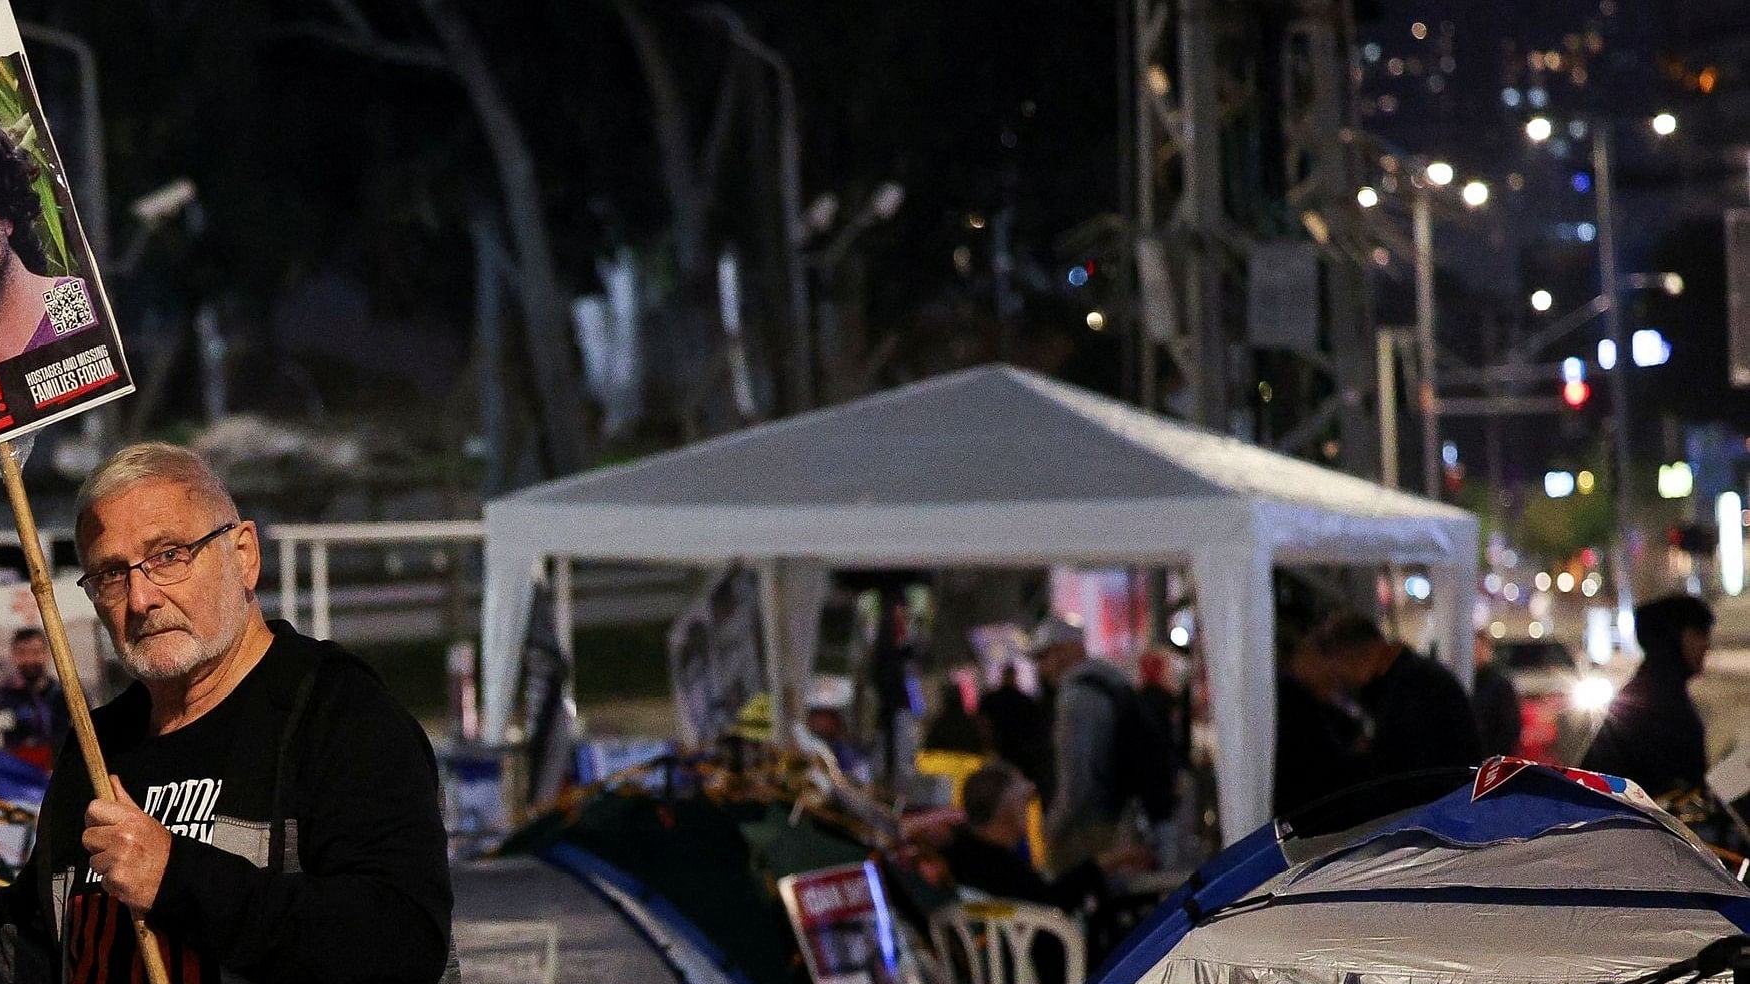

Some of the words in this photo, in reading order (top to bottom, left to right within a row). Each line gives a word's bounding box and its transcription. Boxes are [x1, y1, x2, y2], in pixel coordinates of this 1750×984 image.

[24, 362, 64, 387] HOSTAGES
[61, 356, 78, 373] AND
[76, 344, 109, 368] MISSING
[30, 371, 79, 405] FAMILIES
[76, 356, 116, 387] FORUM
